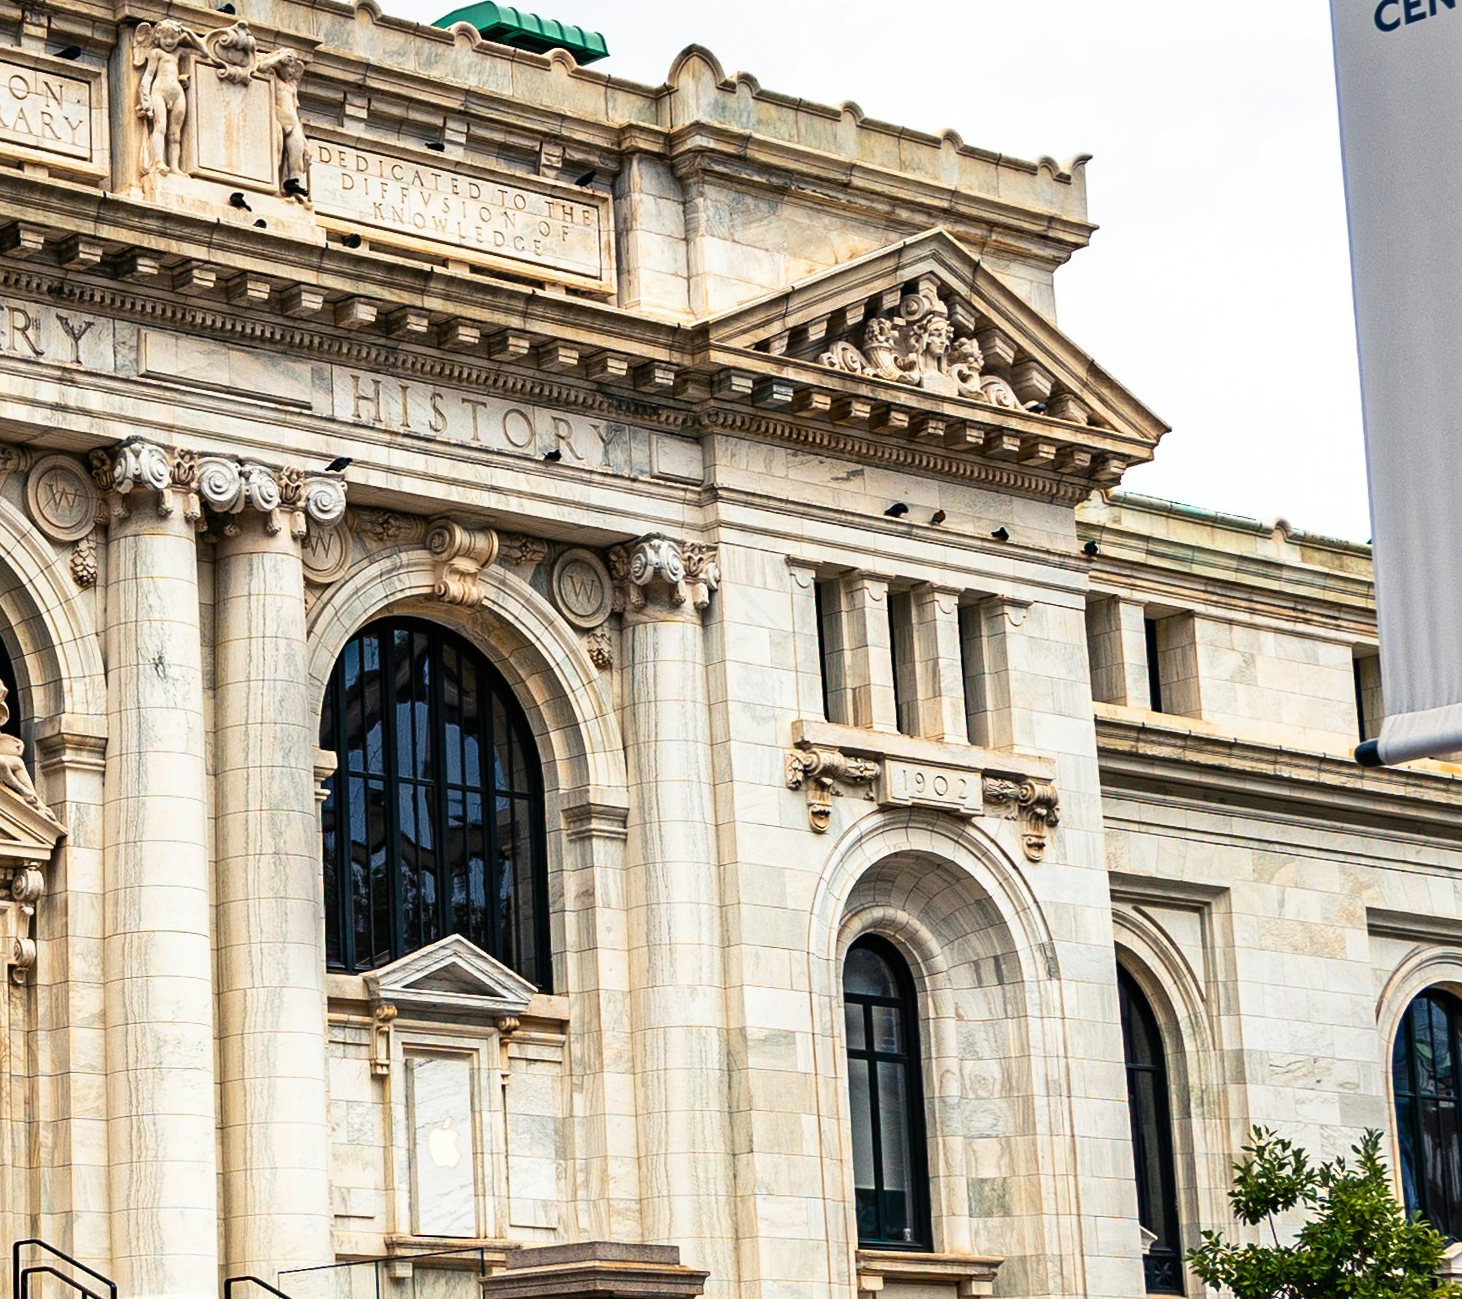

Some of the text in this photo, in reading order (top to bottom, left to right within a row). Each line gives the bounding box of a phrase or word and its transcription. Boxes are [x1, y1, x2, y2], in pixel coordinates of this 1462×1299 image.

[317, 144, 593, 228] DEDICATED TO THE
[341, 172, 571, 242] DIFFVSION OF
[372, 200, 543, 257] KNOWLEDGE
[349, 372, 618, 469] HISTORY
[43, 481, 79, 513] W
[566, 574, 595, 604] W
[902, 769, 969, 800] 1902
